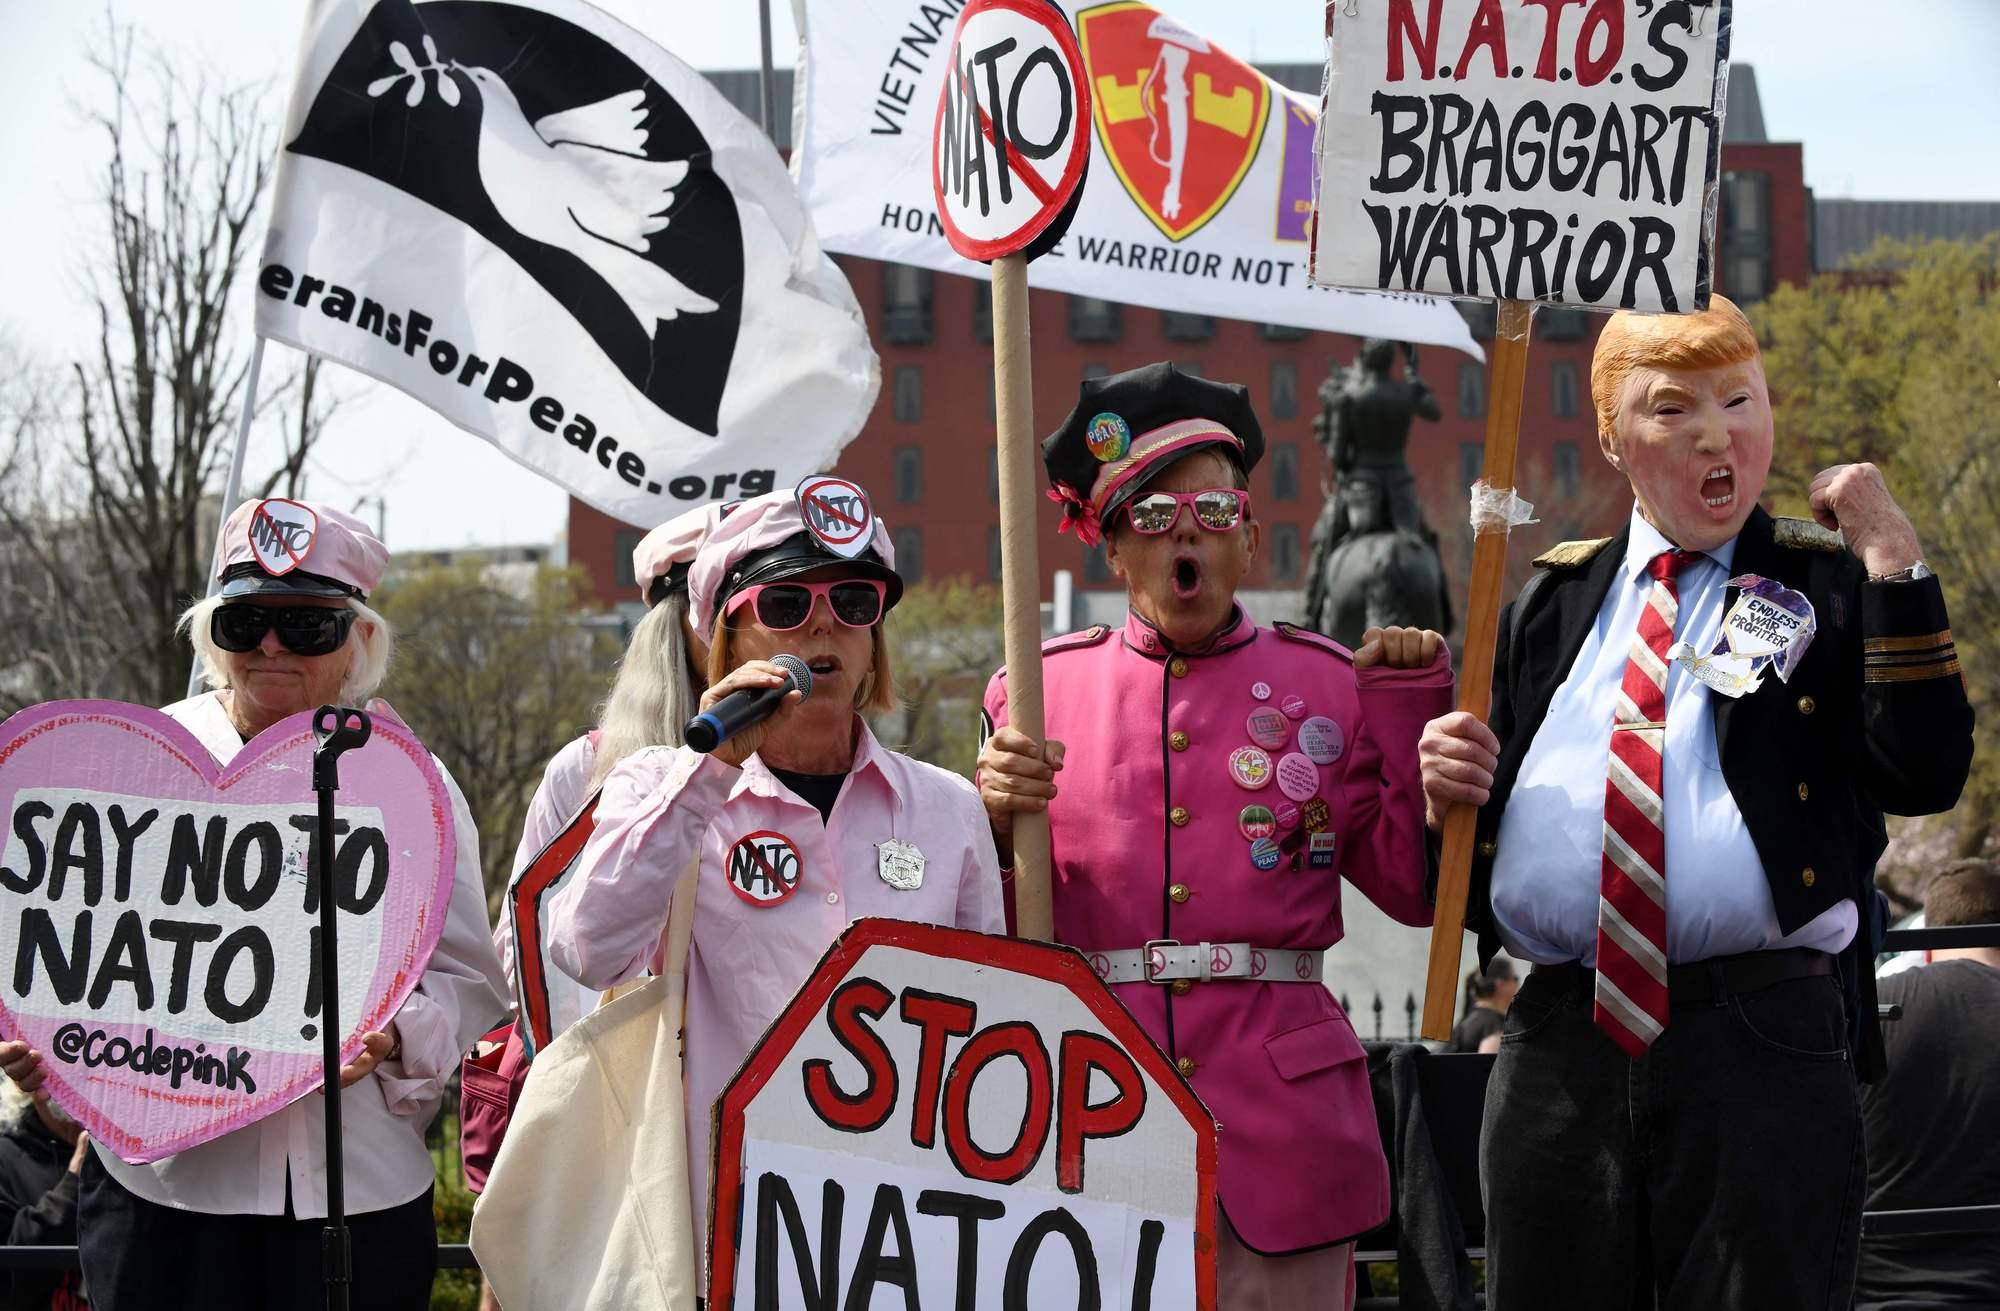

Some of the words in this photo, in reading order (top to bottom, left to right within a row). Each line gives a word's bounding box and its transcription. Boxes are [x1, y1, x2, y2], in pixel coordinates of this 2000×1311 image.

[943, 37, 1072, 217] NATO
[1370, 90, 1714, 206] BRAGGART
[881, 203, 945, 237] HON
[1078, 235, 1222, 278] WARRIOR
[1231, 256, 1294, 287] NOT
[1088, 418, 1126, 446] PEACE
[251, 511, 312, 557] NATO
[802, 495, 865, 532] NATO
[1730, 614, 1789, 648] PROFITEER
[1747, 600, 1800, 630] ENDLESS
[1750, 613, 1781, 633] WAR
[0, 801, 158, 908] SAY
[161, 813, 284, 911] NO
[289, 814, 390, 915] TO
[731, 842, 800, 895] NATO
[1257, 854, 1278, 866] PEACE
[802, 977, 1147, 1193] STOP
